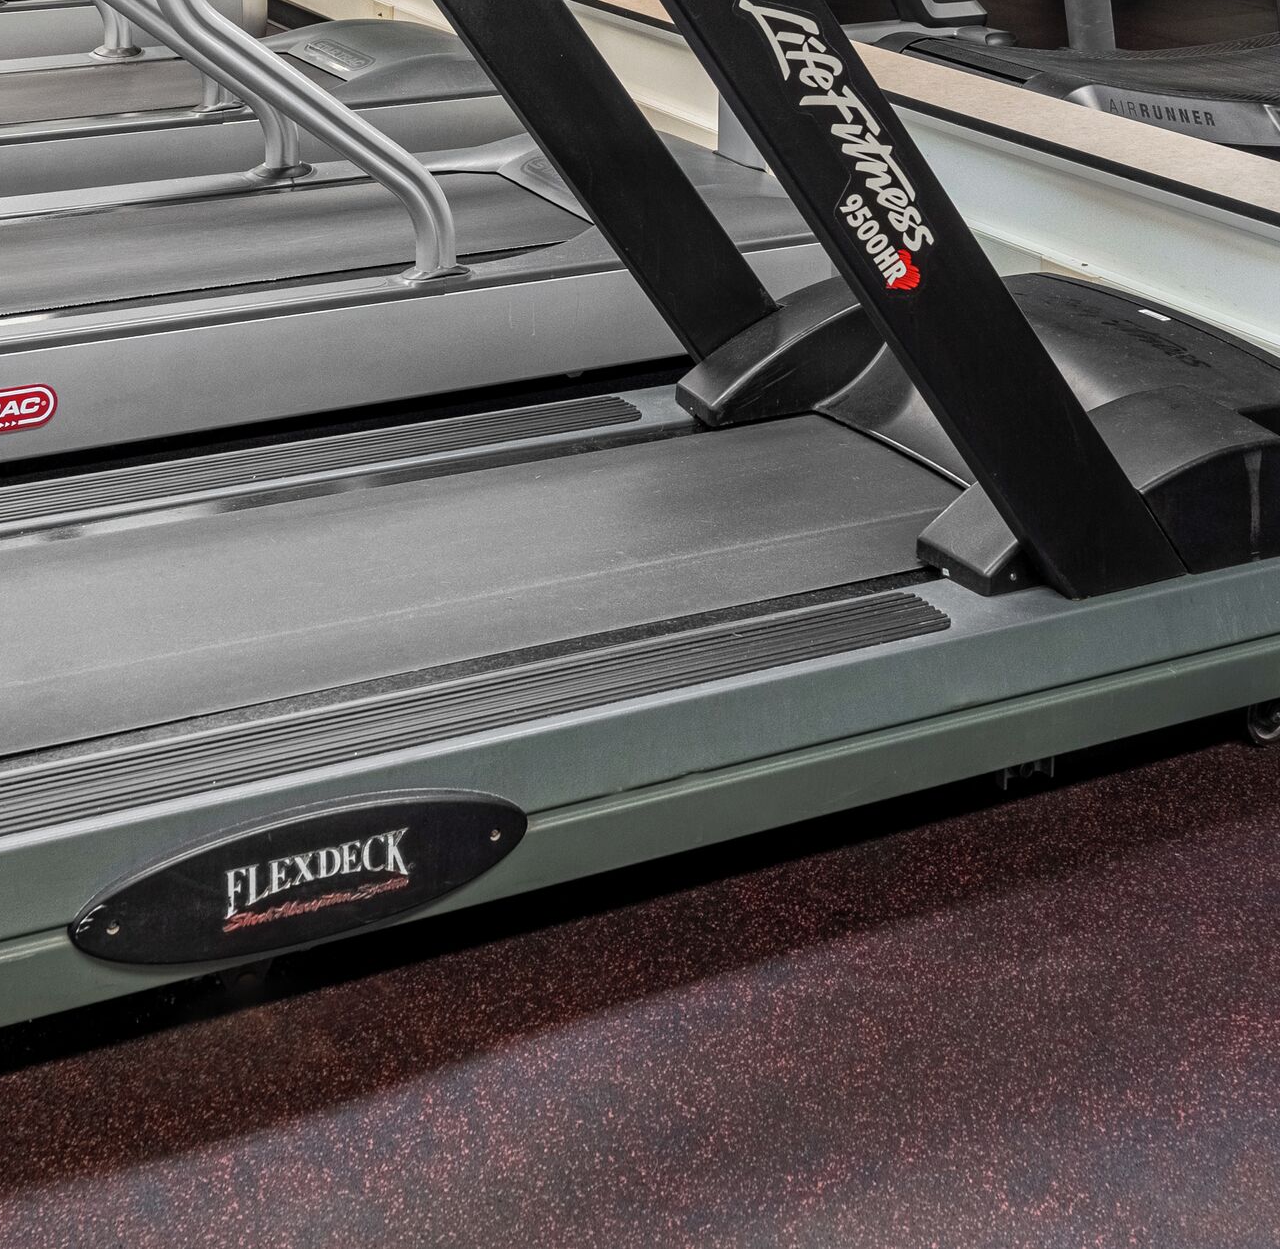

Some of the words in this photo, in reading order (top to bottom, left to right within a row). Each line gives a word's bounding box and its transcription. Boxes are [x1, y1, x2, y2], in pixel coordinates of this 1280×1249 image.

[799, 85, 935, 252] Fitness
[839, 194, 908, 286] 9500HR
[224, 827, 410, 921] FLEXDECK
